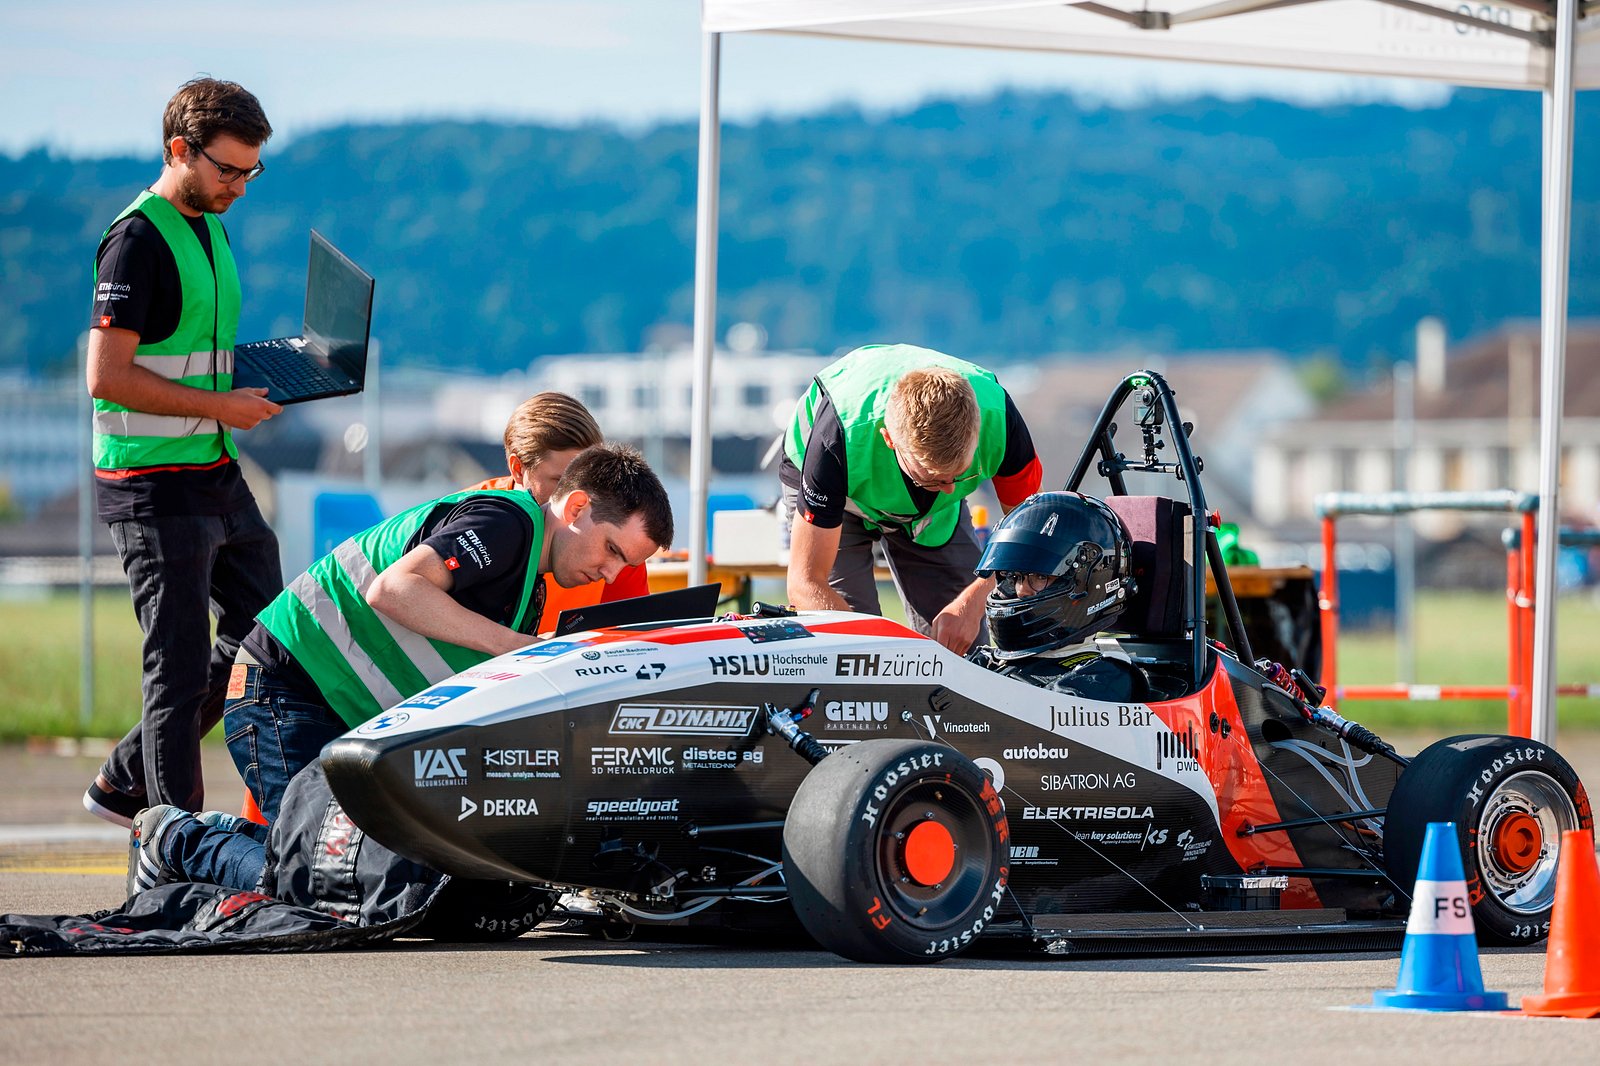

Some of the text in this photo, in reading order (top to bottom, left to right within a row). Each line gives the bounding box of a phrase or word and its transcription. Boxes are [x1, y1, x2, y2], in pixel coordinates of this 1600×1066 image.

[456, 535, 475, 552] HSLU
[708, 654, 769, 676] HSLU
[772, 654, 828, 666] Hochschule
[575, 664, 628, 677] RUAG
[773, 666, 805, 676] Luzern
[408, 695, 452, 705] EKZ
[660, 708, 752, 728] DYNAMIX
[825, 702, 888, 721] GENU
[1049, 705, 1154, 731] Julius Bär
[618, 718, 646, 730] CNC
[824, 723, 888, 731] PARTNER AG
[943, 721, 990, 733] Vincotech
[484, 750, 560, 766] KISTLER
[591, 747, 674, 766] FERAMIC
[683, 747, 763, 764] distec ag
[1003, 743, 1068, 760] autobau
[413, 748, 468, 781] VAC
[592, 767, 675, 775] 3D METALLDRUCK
[1177, 759, 1199, 773] pwb
[1040, 772, 1136, 791] SIBATRON AG
[1466, 745, 1547, 808] Hoosier
[862, 751, 944, 830] Hoosier
[483, 798, 539, 817] DEKRA
[587, 798, 680, 816] speedgoat
[1022, 806, 1155, 820] ELEKTRISOLA
[1075, 831, 1142, 842] lean key solutions
[867, 896, 893, 931] FL
[1434, 897, 1466, 919] FS
